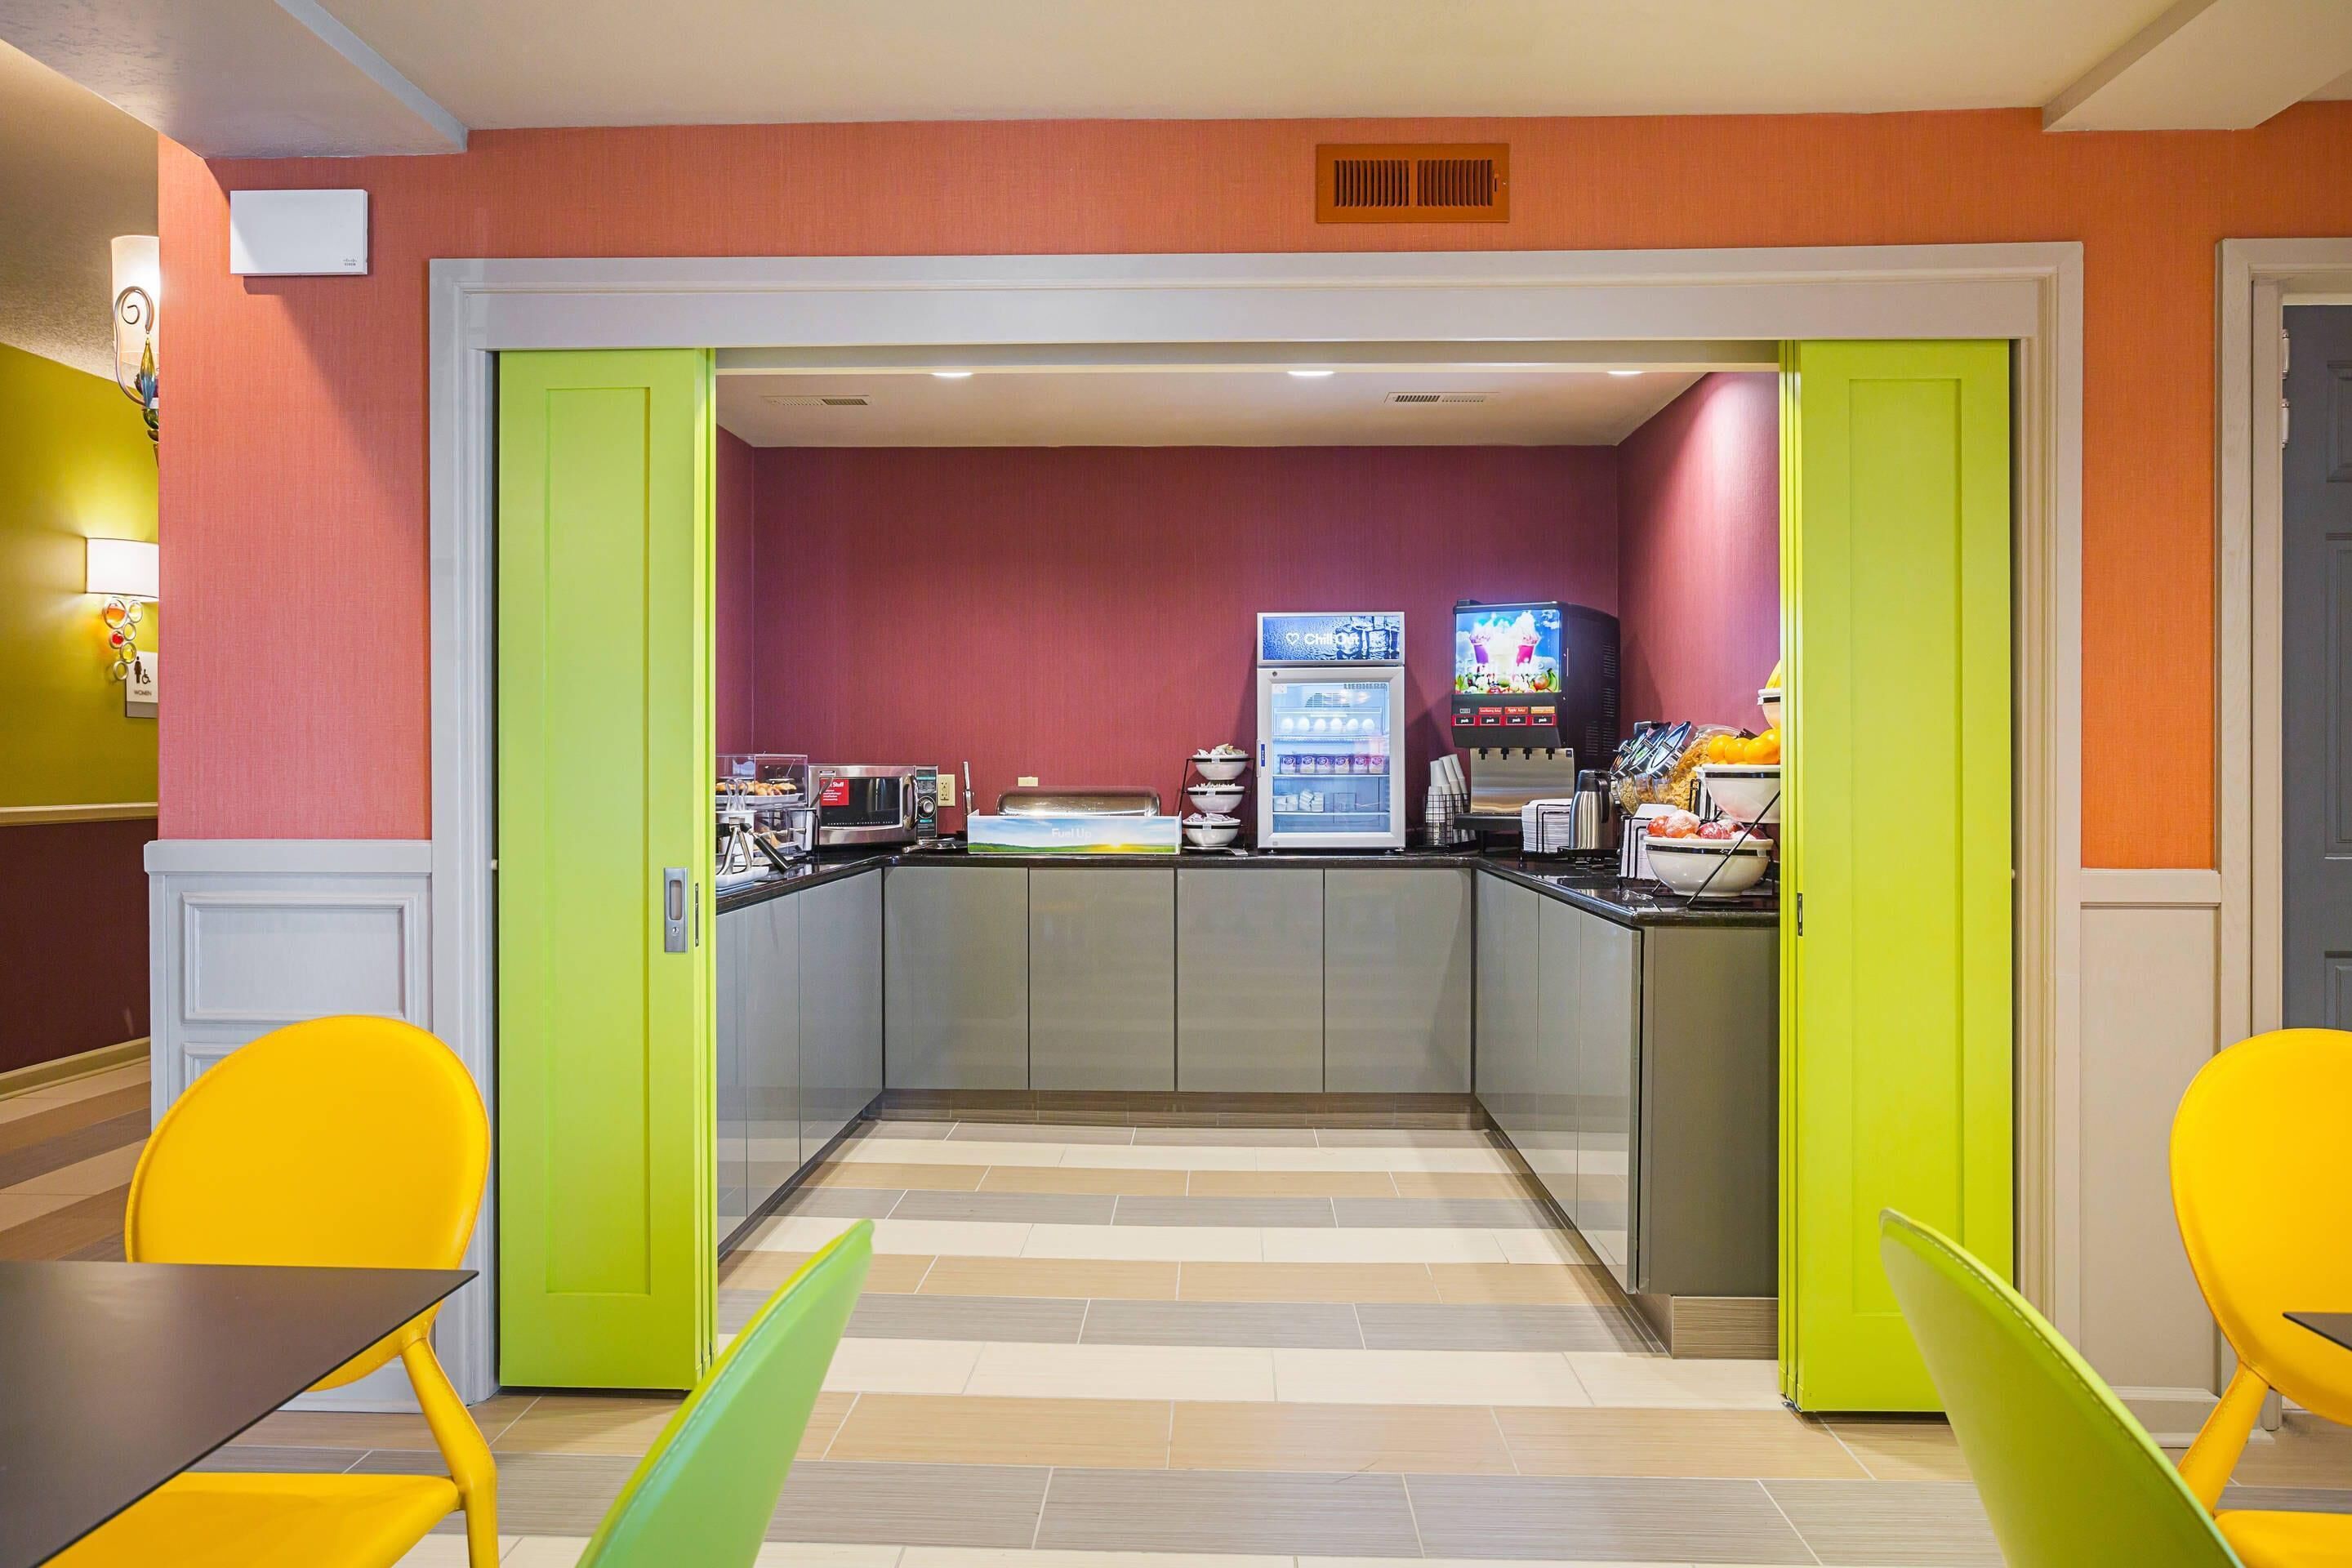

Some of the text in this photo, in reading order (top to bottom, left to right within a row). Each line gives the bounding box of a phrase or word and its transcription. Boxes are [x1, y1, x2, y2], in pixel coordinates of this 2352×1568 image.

[1304, 632, 1360, 645] Chill Out
[1051, 828, 1092, 842] Fuel Up
